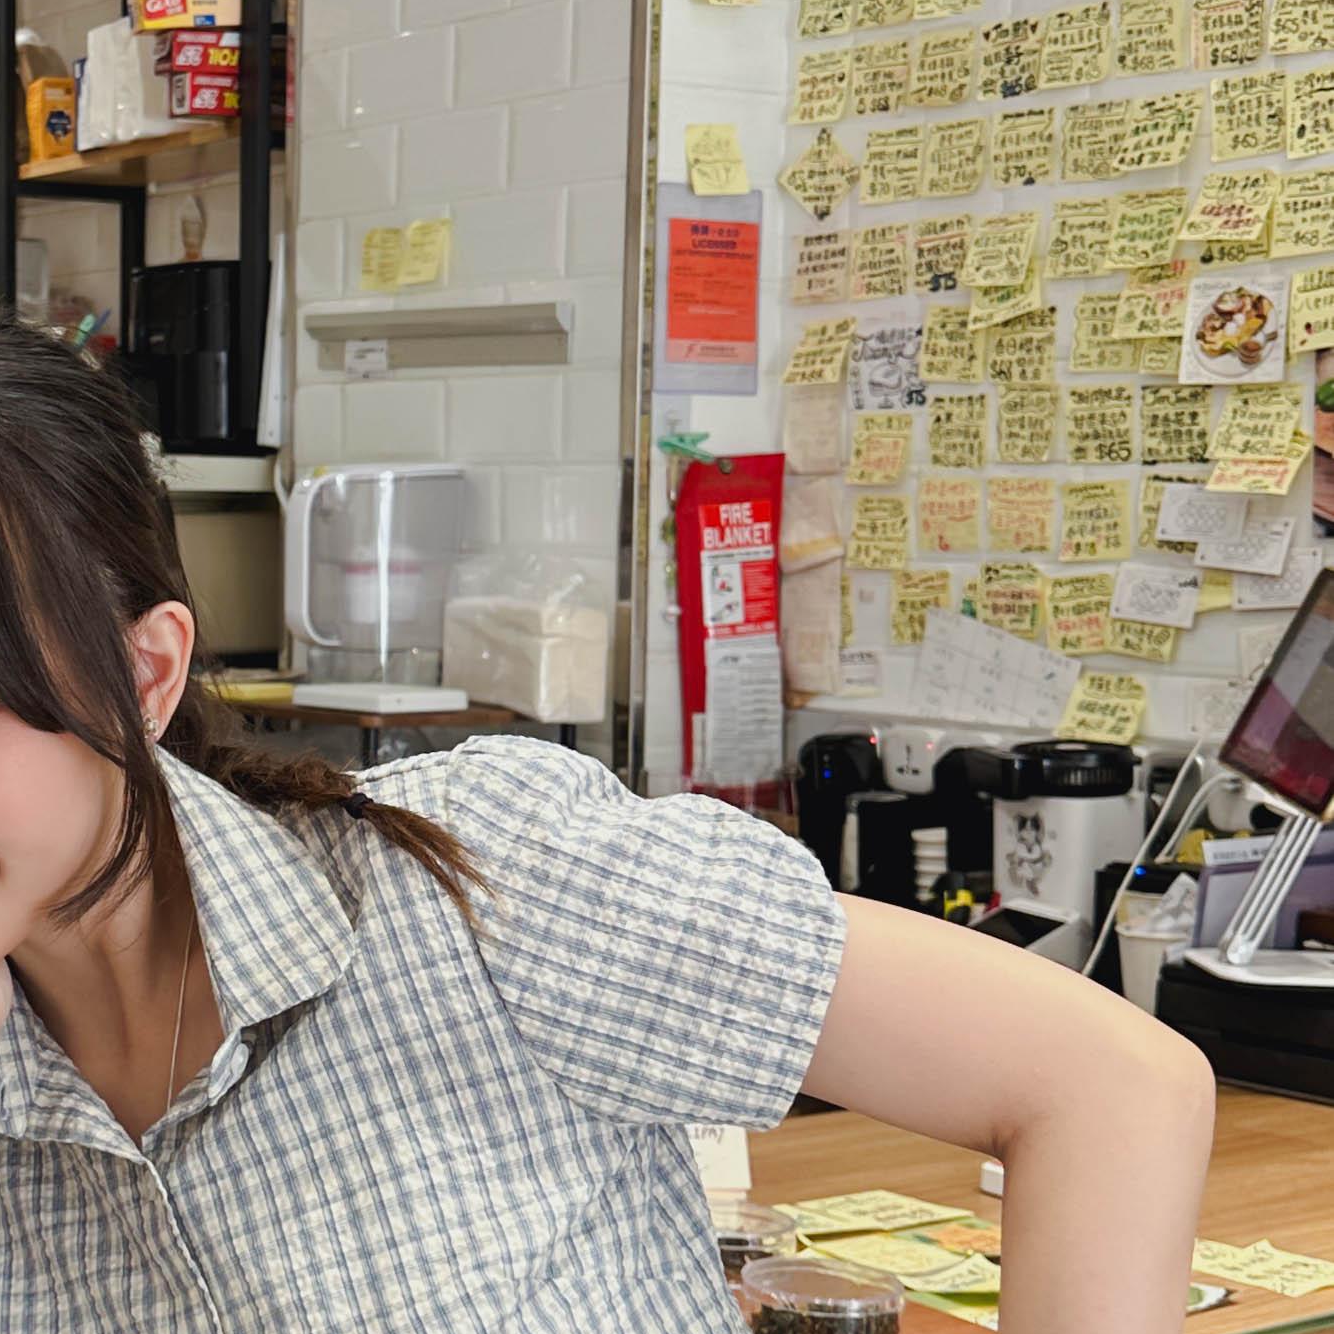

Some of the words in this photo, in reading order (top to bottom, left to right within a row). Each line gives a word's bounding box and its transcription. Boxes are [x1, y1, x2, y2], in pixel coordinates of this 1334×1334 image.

[1095, 440, 1132, 462] $65
[719, 502, 754, 526] FIRE
[703, 522, 772, 550] BLANKET
